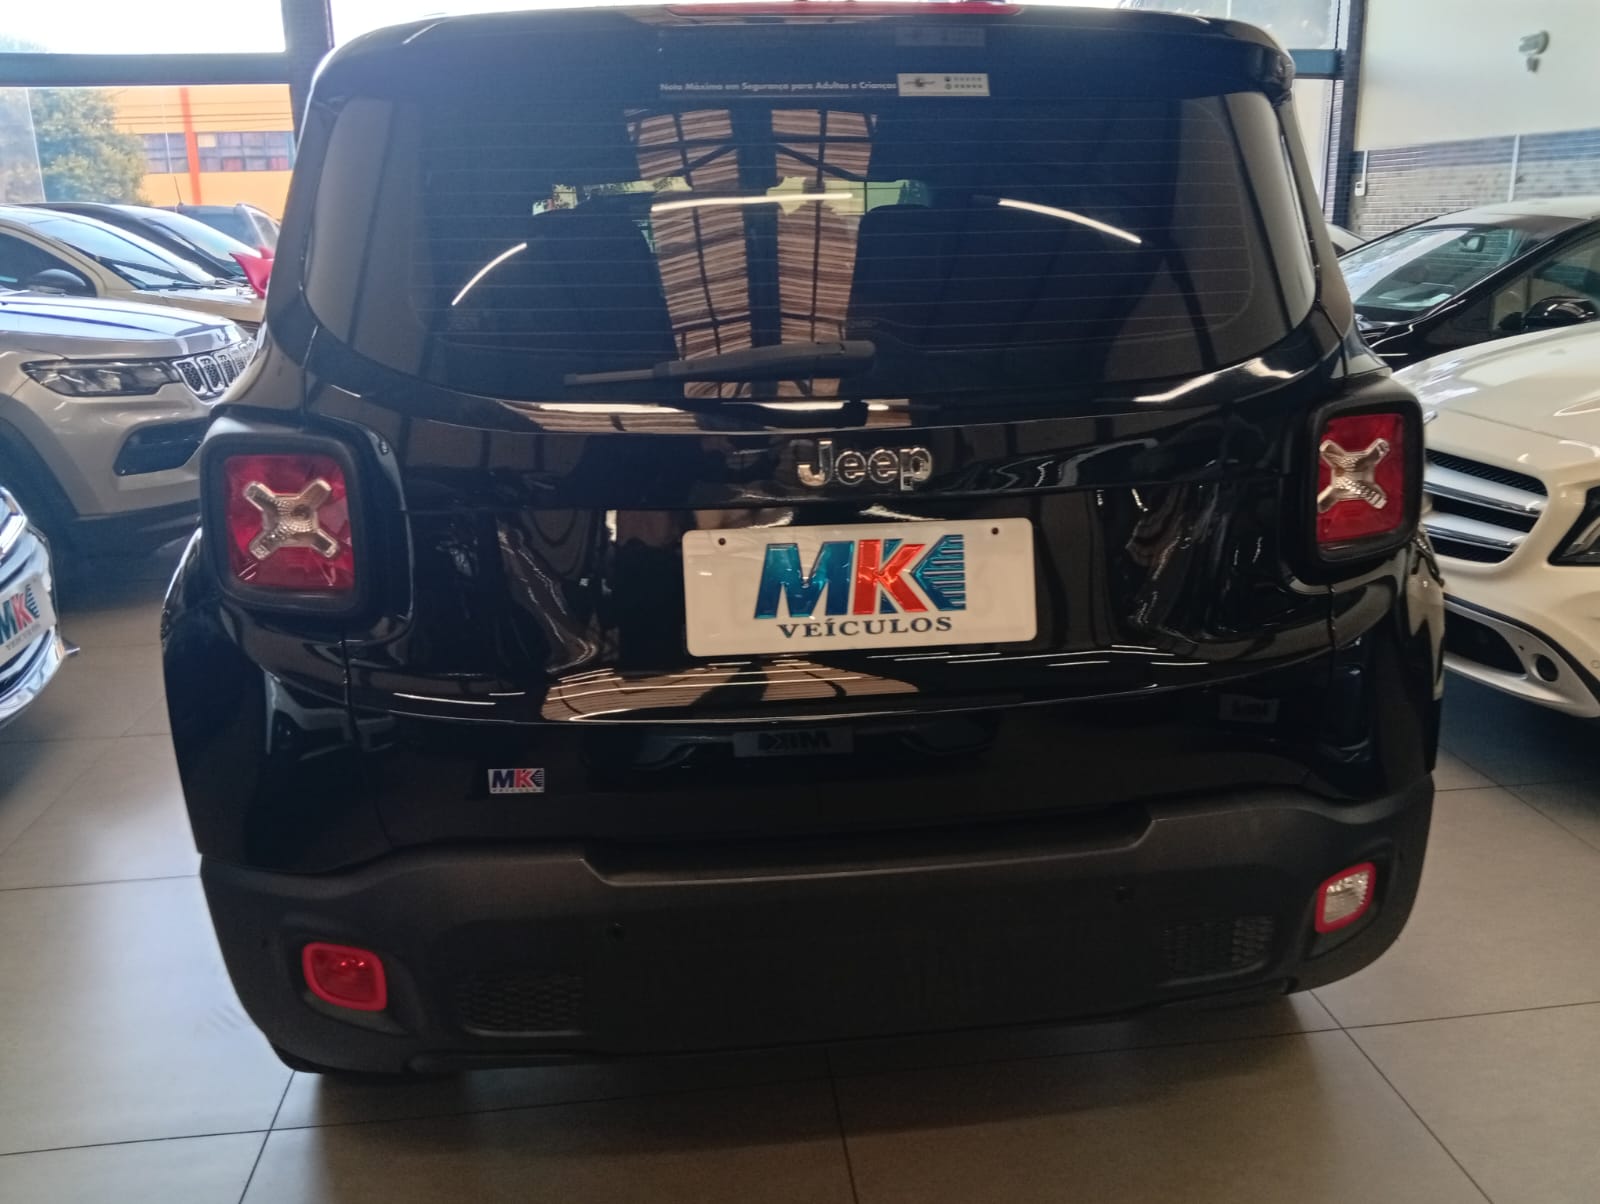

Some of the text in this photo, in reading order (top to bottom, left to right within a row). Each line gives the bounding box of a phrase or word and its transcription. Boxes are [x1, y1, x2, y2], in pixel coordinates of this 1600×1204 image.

[741, 81, 789, 93] Segurança
[791, 82, 813, 92] para
[815, 80, 849, 90] Adultos
[859, 80, 897, 91] Crianças
[797, 439, 933, 491] Jeep
[777, 616, 952, 639] VEÍCULOS
